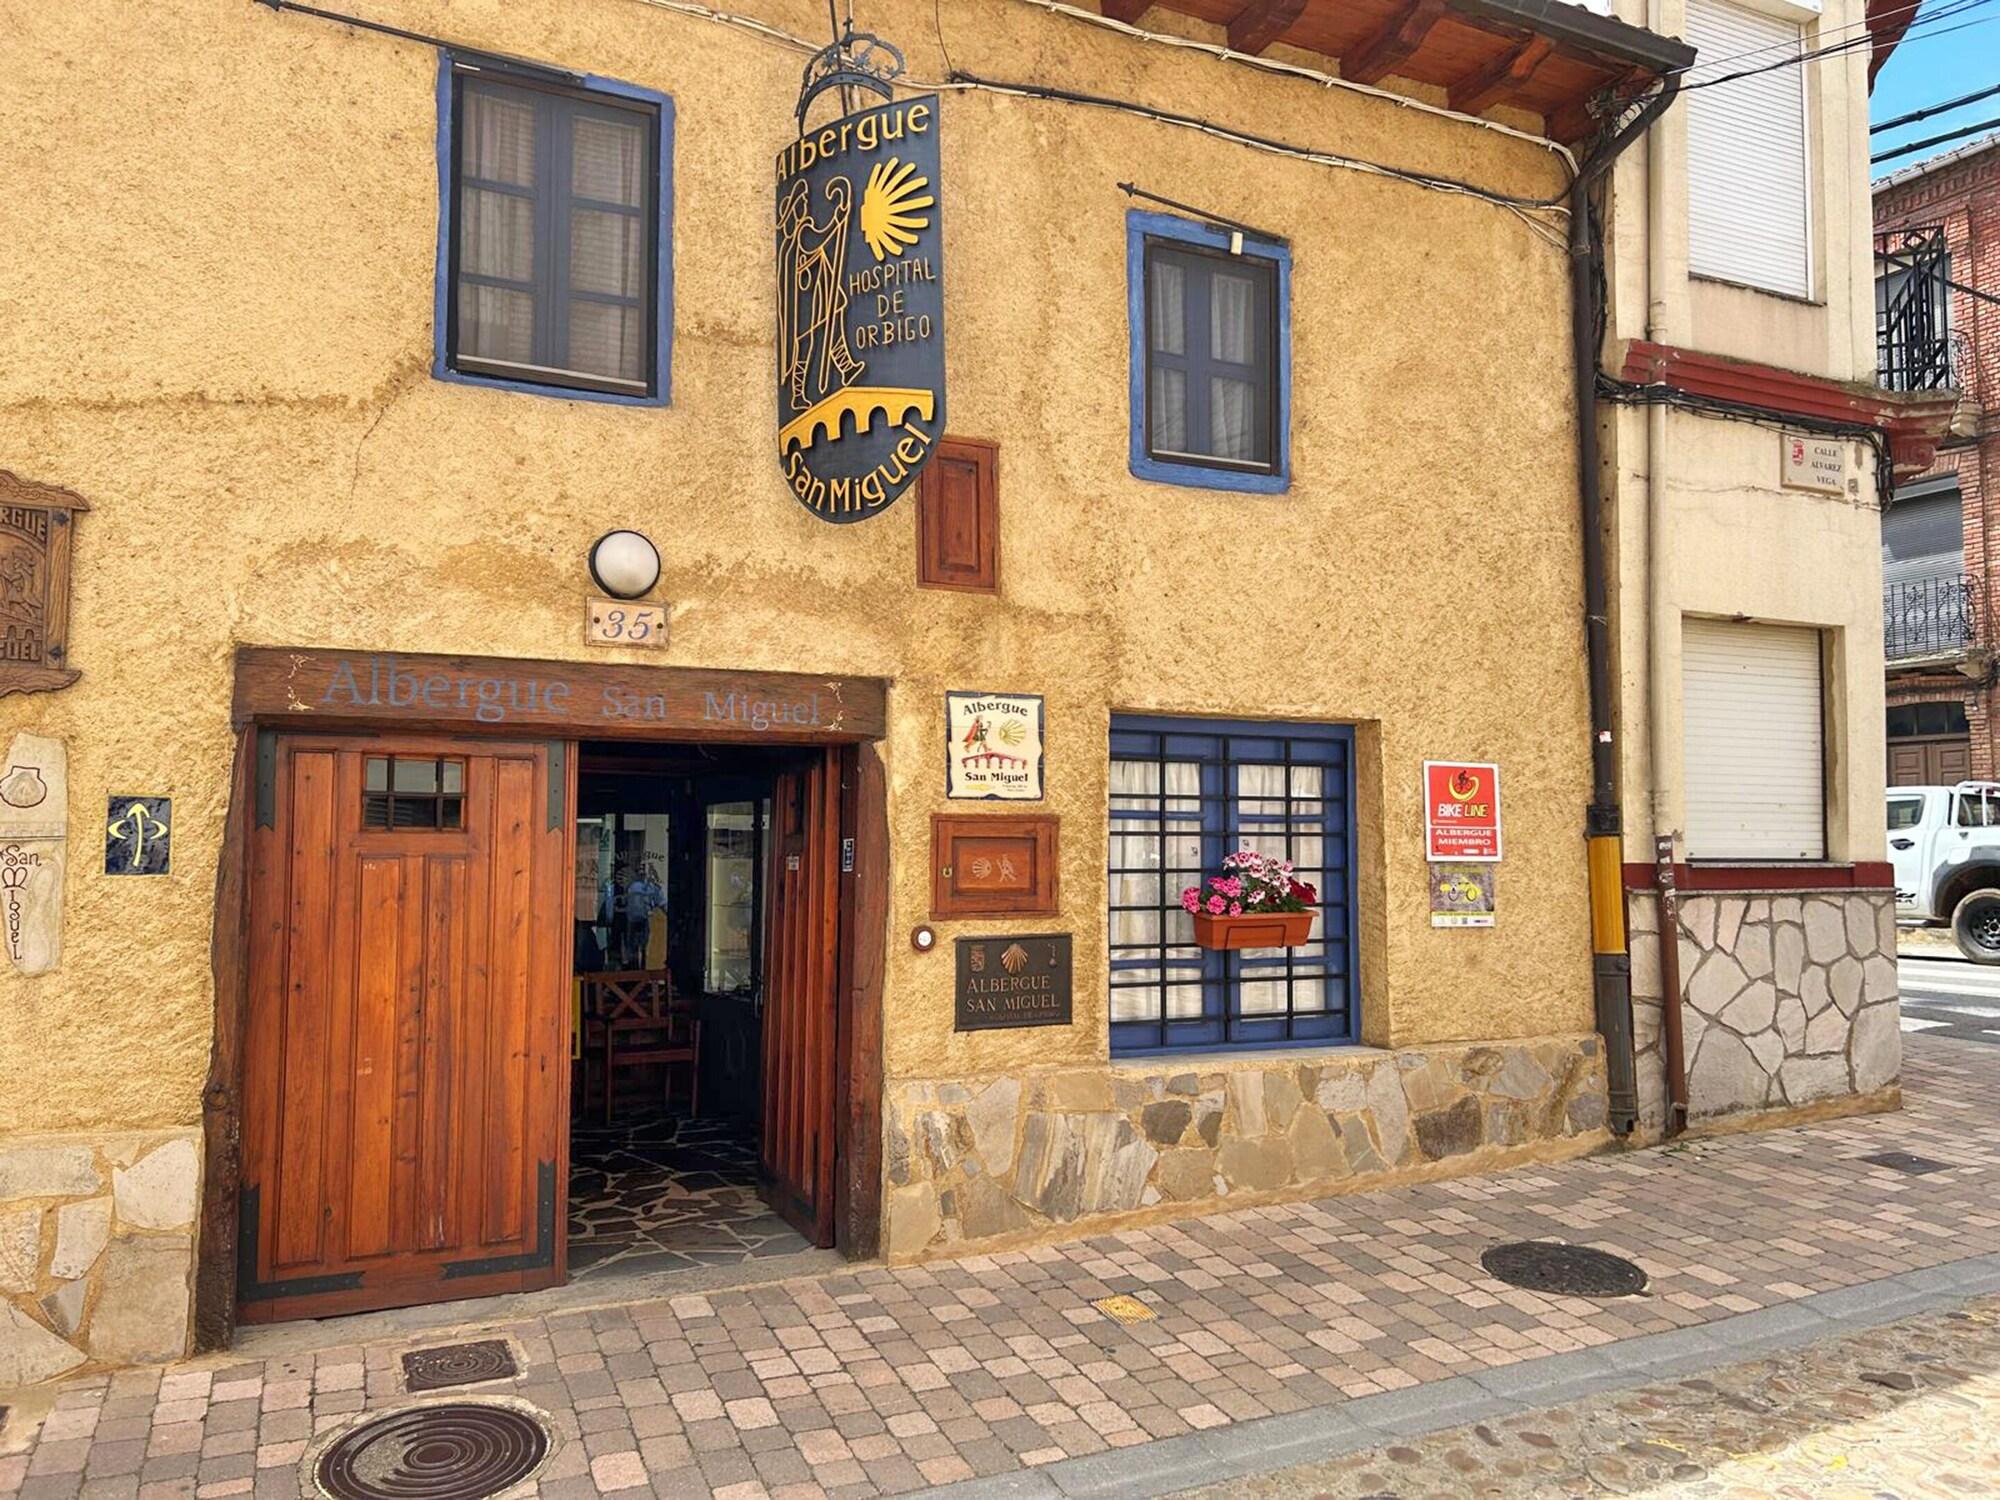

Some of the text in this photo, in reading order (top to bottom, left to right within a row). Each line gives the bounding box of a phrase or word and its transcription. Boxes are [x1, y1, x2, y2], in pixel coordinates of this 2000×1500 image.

[775, 103, 930, 181] Albergue
[849, 257, 936, 296] HOSPITAL
[877, 289, 904, 317] DE
[856, 315, 930, 349] ORBIGO
[1814, 447, 1837, 457] CALLE
[1816, 475, 1837, 485] VEGA
[602, 610, 653, 640] 35
[320, 655, 820, 731] Albergue San Miguel
[963, 701, 1028, 716] Albergue
[964, 771, 1029, 784] San Miguel
[1438, 804, 1488, 817] BIKE LINE
[5, 844, 42, 867] San
[966, 975, 1051, 994] ALBERGUE
[966, 994, 1060, 1013] SAN MIGUEL
